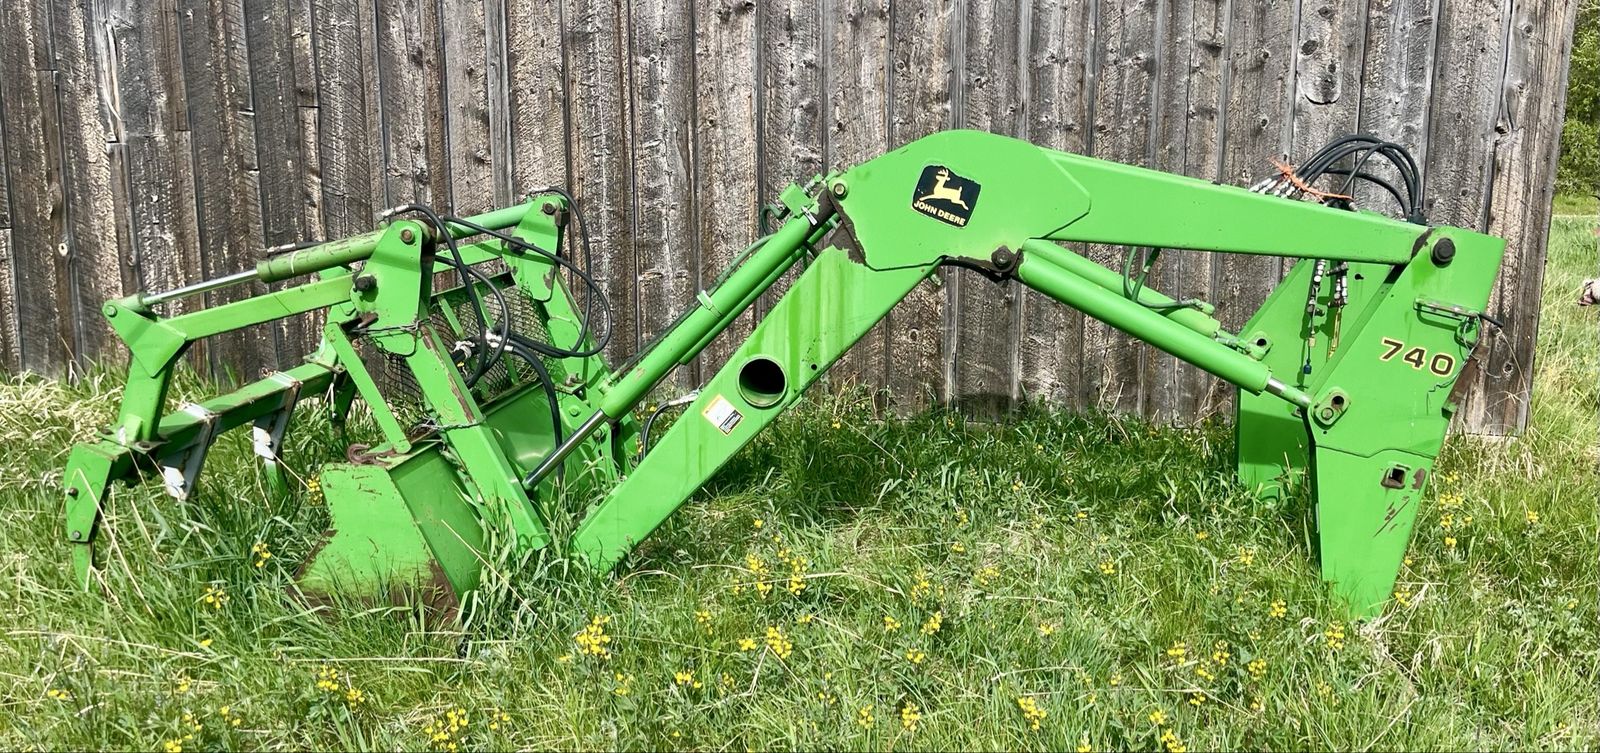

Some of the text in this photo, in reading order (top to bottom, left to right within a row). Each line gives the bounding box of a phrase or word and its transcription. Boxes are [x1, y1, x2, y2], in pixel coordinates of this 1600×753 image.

[913, 200, 966, 226] JOHN DEERE
[1381, 338, 1455, 377] 740
